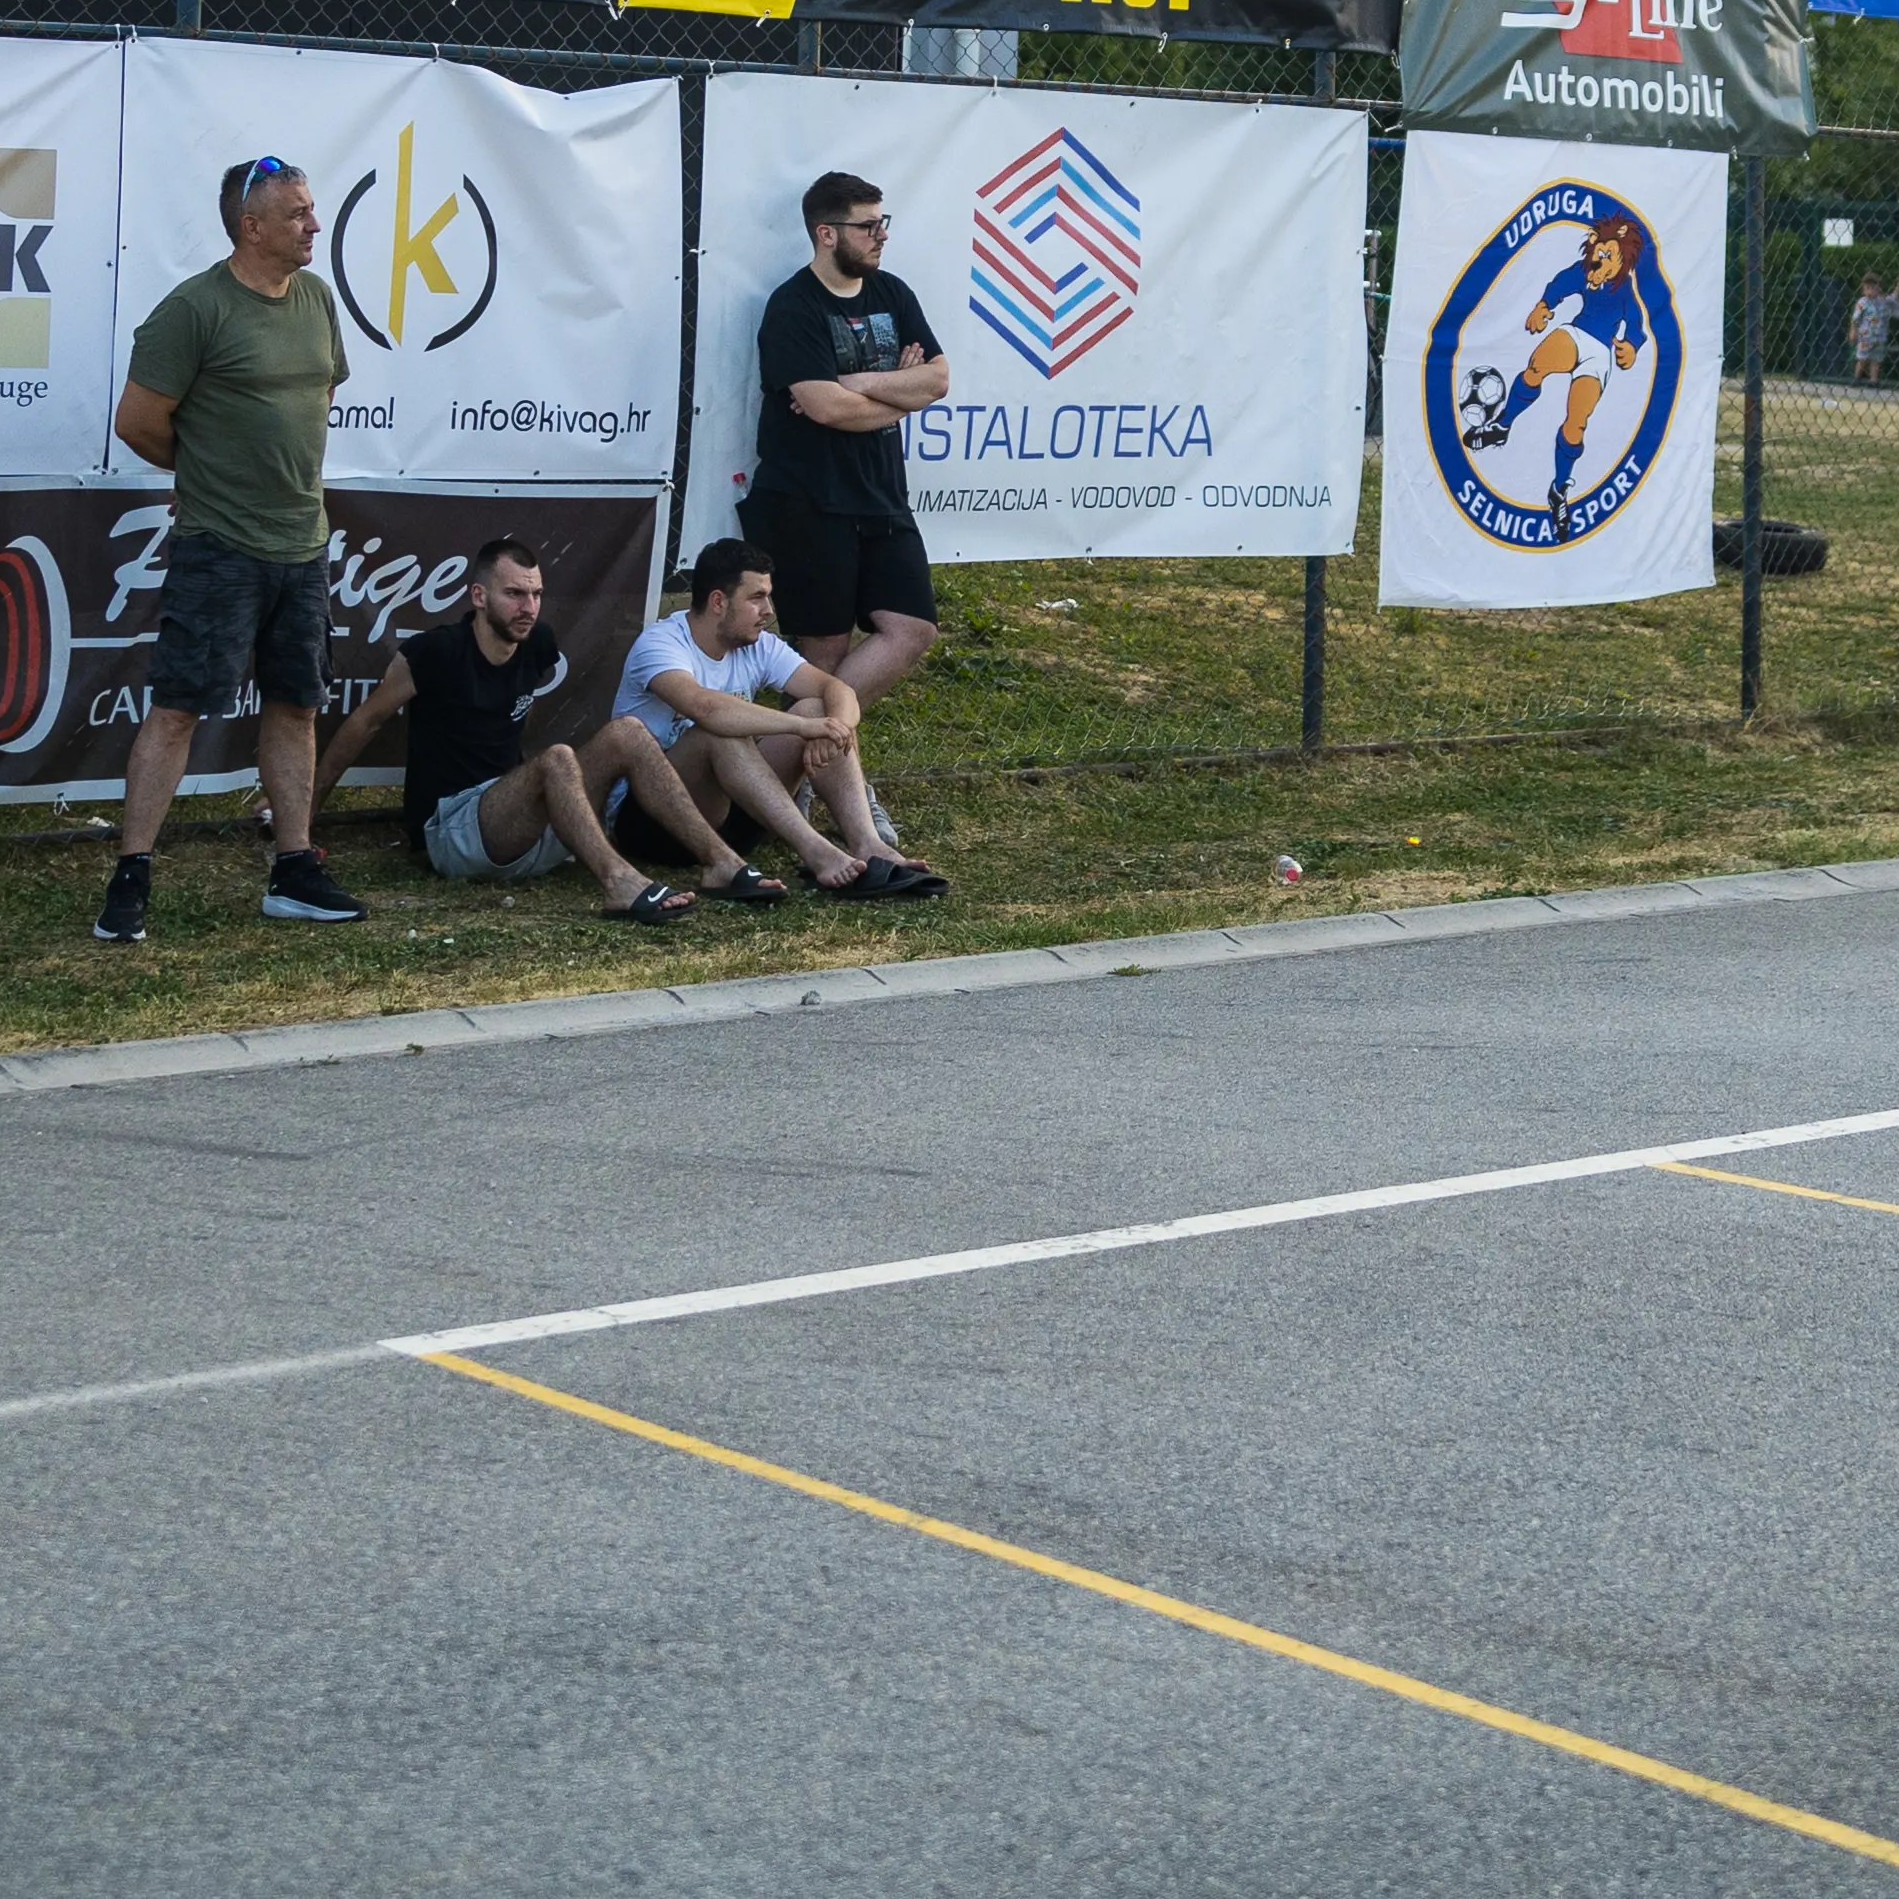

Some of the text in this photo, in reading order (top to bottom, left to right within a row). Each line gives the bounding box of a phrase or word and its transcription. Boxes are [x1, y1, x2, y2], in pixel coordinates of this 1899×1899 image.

[1504, 60, 1725, 118] Automobili
[1504, 189, 1595, 249] UDRUGA
[327, 397, 652, 443] ama! info@kivag.hr
[902, 403, 1214, 461] STALOTEKA
[908, 484, 1332, 513] LIMATIZACIJA VODOVOD ODVODNJA
[1457, 453, 1643, 543] SELNICA SPORT
